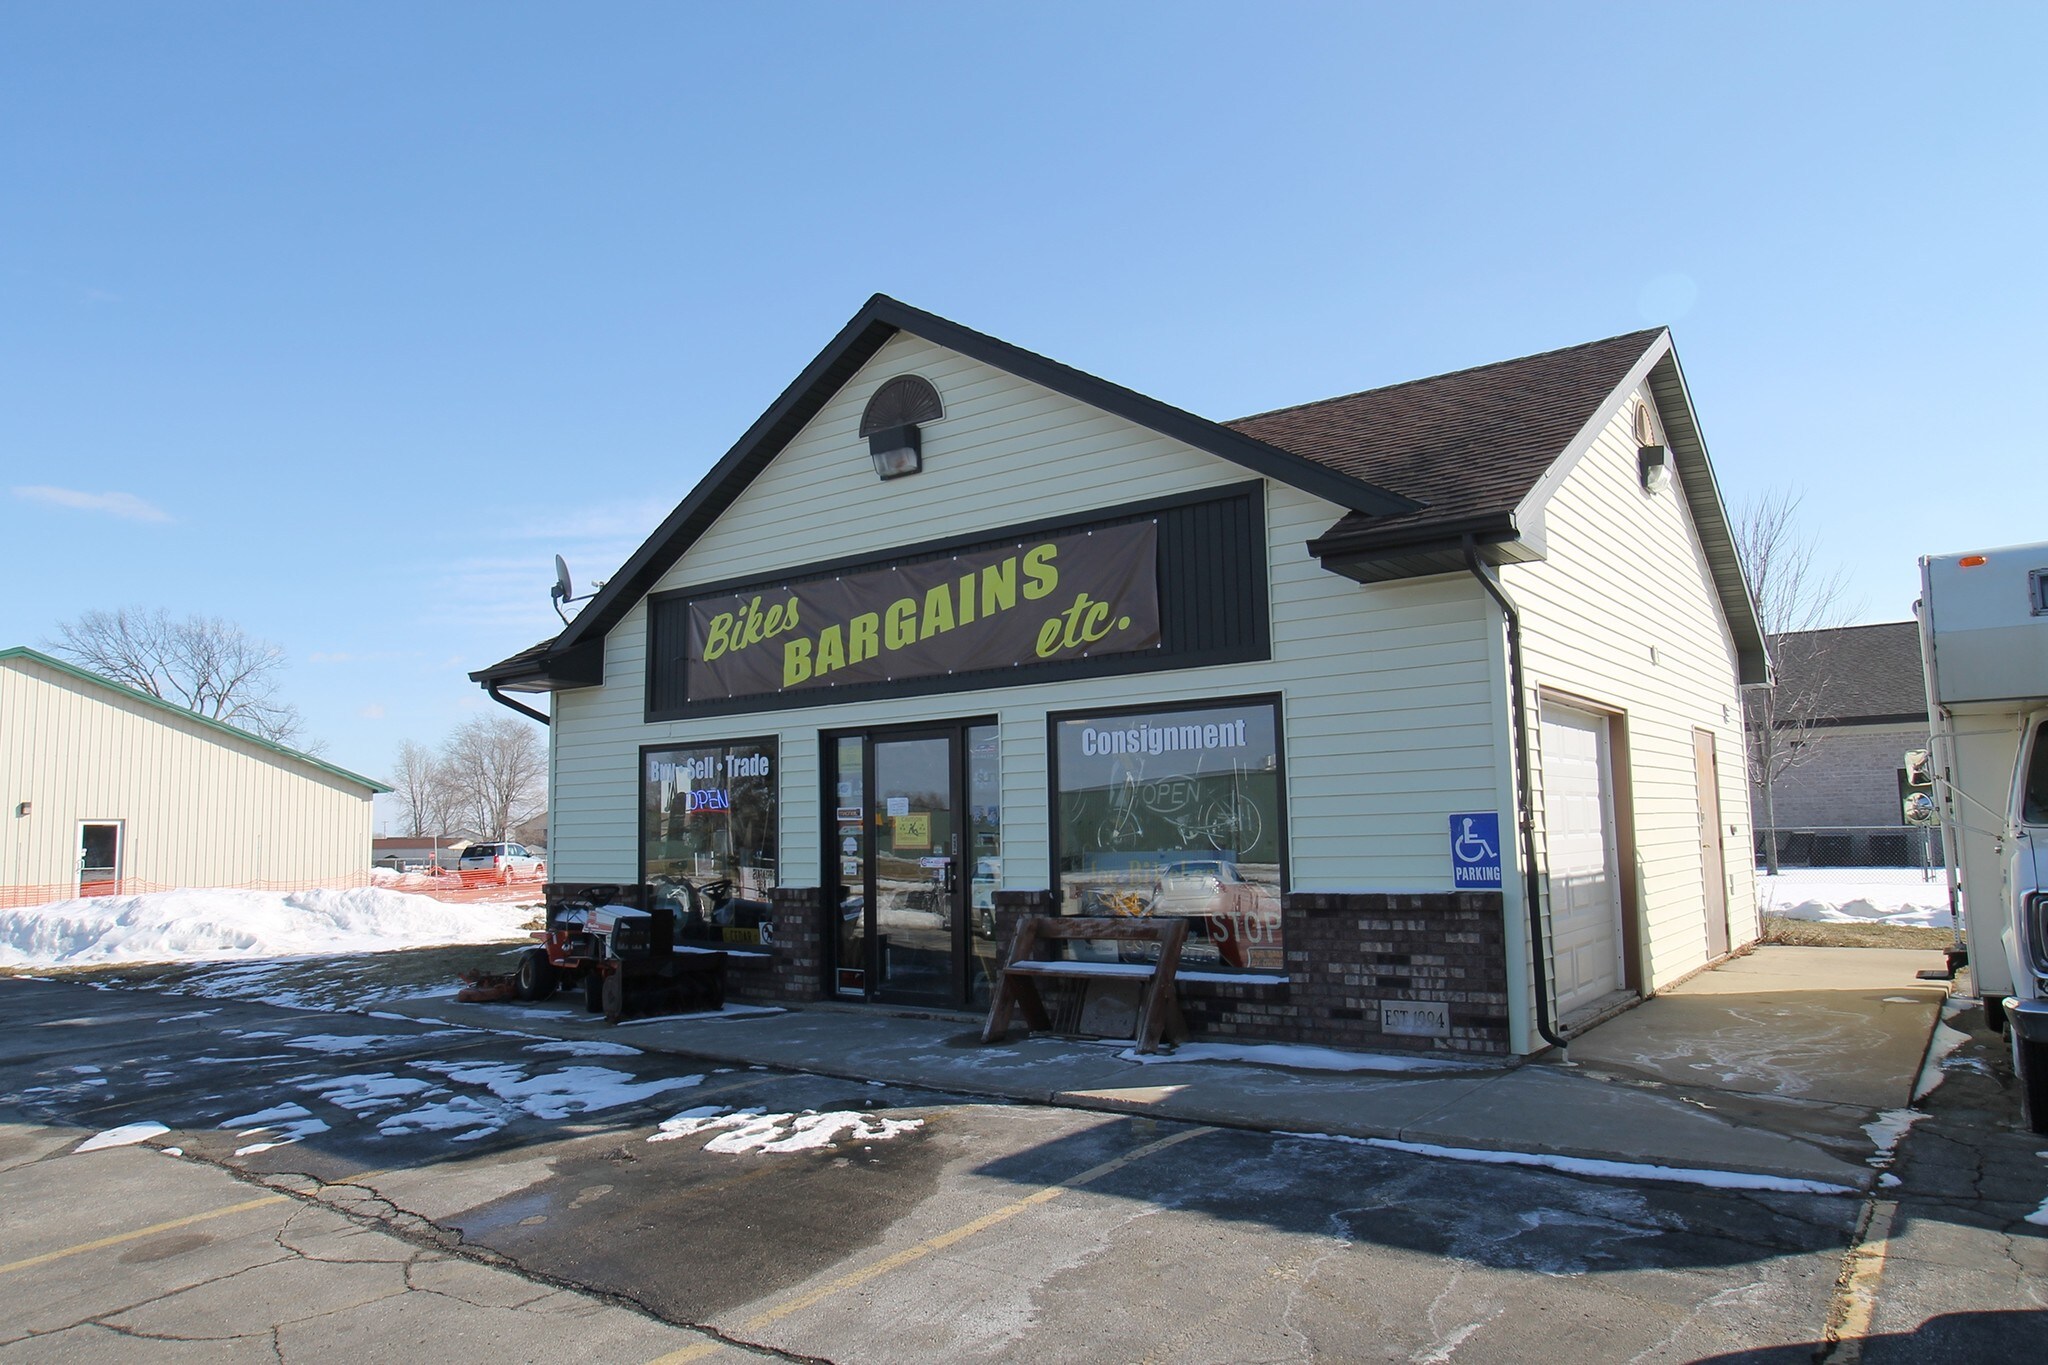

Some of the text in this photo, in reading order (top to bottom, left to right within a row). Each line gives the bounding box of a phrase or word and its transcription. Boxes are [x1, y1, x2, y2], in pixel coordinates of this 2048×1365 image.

[703, 596, 801, 662] Bikes
[783, 543, 1059, 688] BARGAINS
[1035, 592, 1132, 659] etc.
[1082, 718, 1247, 756] Consignment
[650, 753, 769, 782] Buy Sell Trade
[686, 788, 729, 810] OPEN
[1142, 781, 1200, 806] OPEN
[1456, 865, 1501, 882] PARKING
[1212, 911, 1282, 944] STOP
